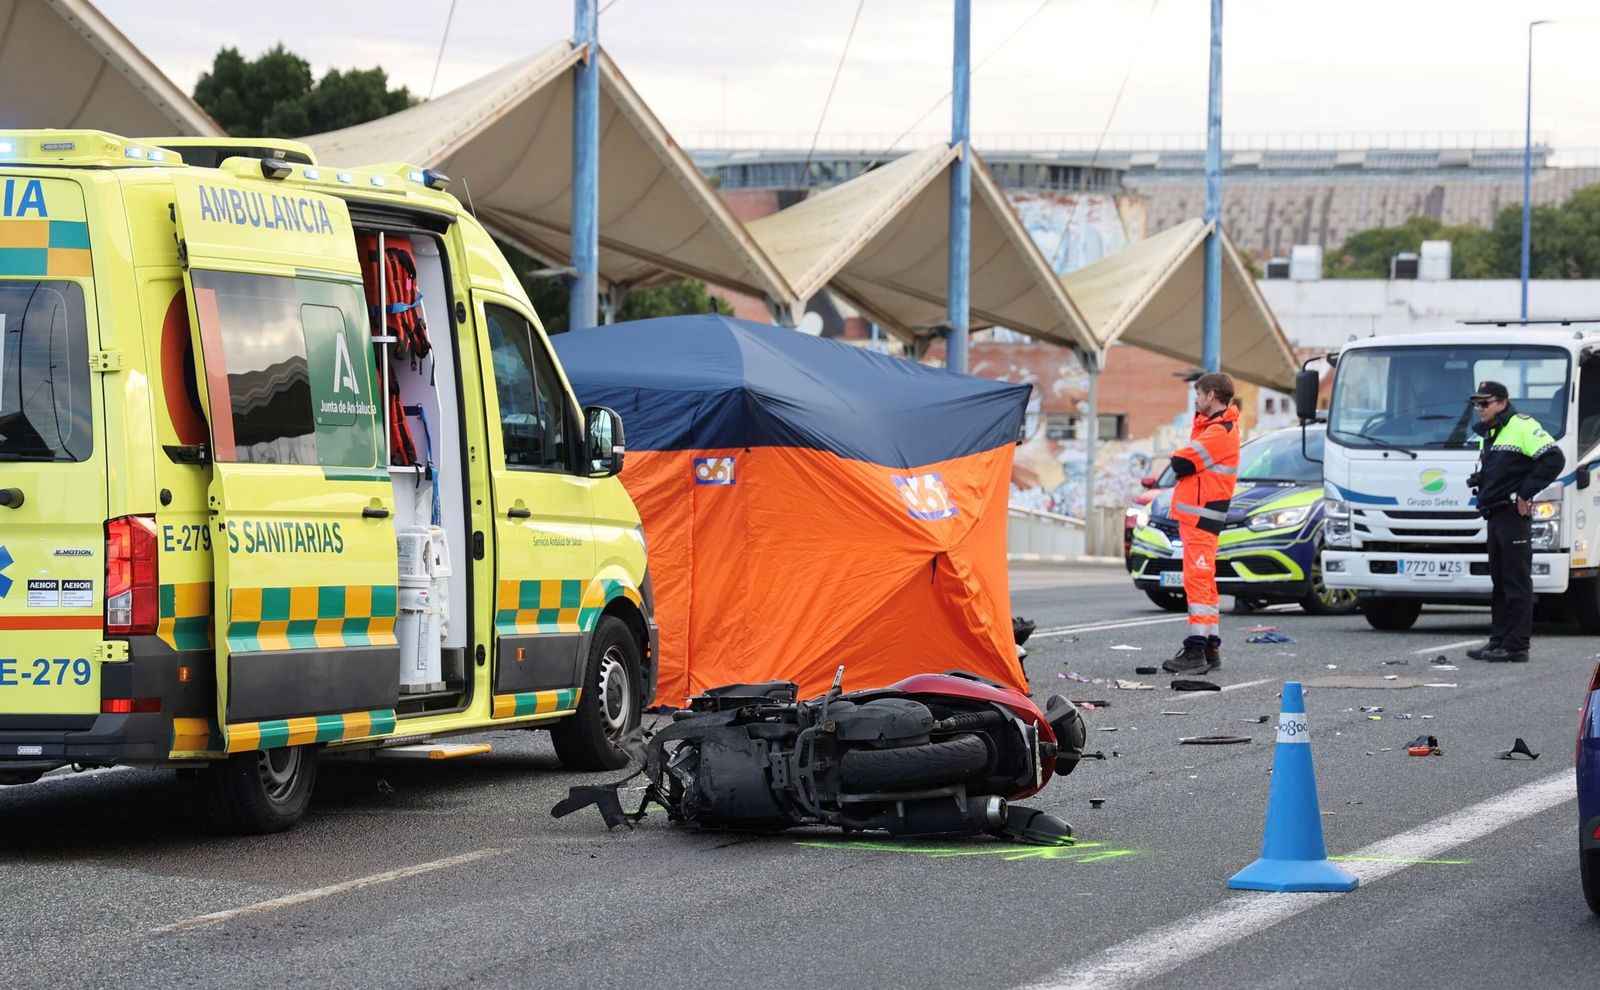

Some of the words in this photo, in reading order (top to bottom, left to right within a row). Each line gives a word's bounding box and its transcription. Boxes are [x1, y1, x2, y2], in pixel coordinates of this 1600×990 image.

[3, 179, 49, 217] IA
[198, 184, 334, 235] AMBULANCIA
[320, 399, 338, 413] Junta
[338, 400, 347, 414] de
[695, 457, 735, 482] 061
[1407, 498, 1433, 507] Grupo
[163, 525, 212, 551] E-279
[227, 520, 239, 554] S
[243, 521, 344, 554] SANITARIAS
[1406, 561, 1436, 572] 7770
[1439, 561, 1462, 573] MZS
[29, 581, 57, 589] AENOR
[63, 581, 91, 589] AENOR
[0, 658, 91, 685] E-279
